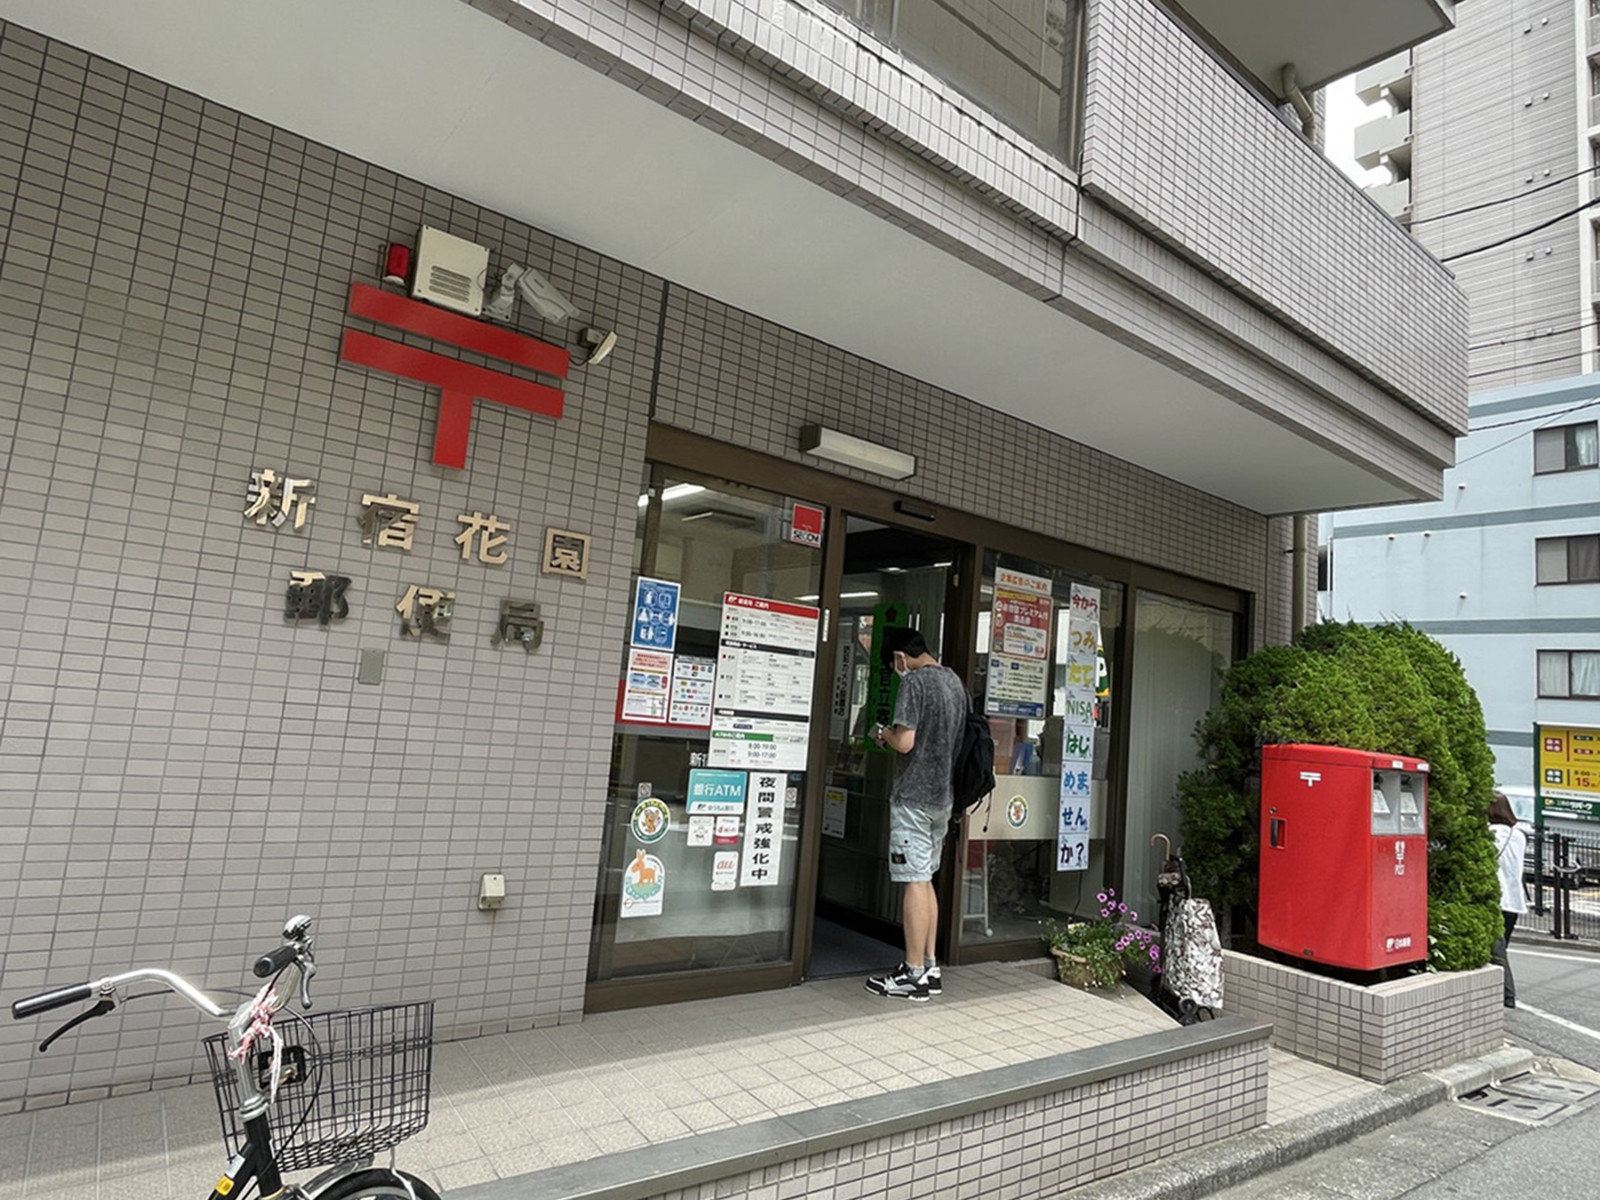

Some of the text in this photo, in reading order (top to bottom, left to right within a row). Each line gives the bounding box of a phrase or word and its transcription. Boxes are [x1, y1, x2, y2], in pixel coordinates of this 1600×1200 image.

[243, 468, 592, 581] 新宿花園
[1071, 631, 1096, 649] つみ
[1069, 663, 1093, 684] たて
[1066, 700, 1092, 716] NISA
[1066, 735, 1090, 754] はじ
[693, 783, 742, 797] 銀行ATM
[1064, 772, 1088, 790] めま
[1062, 807, 1086, 826] せん
[751, 776, 777, 880] 夜間警戒強化中
[1060, 842, 1084, 864] か?
[716, 860, 734, 869] au
